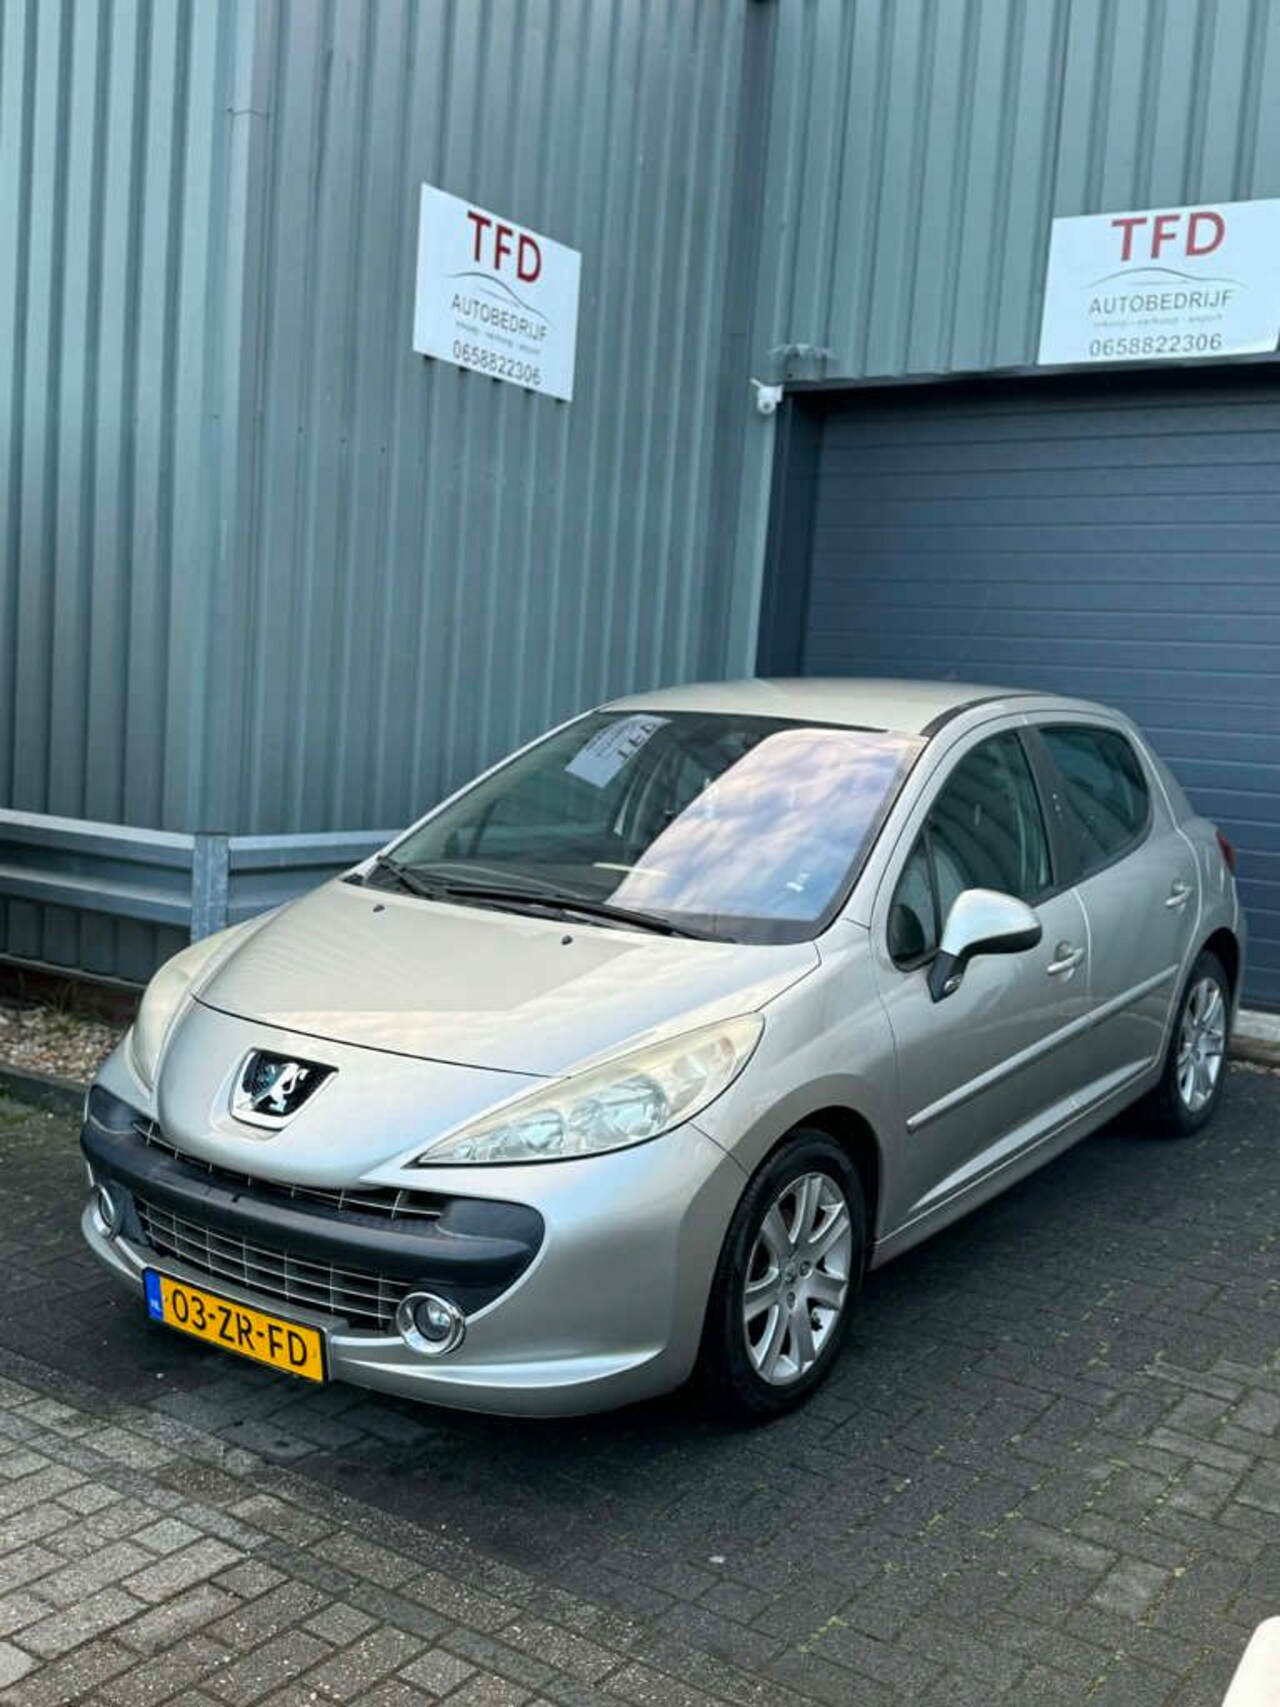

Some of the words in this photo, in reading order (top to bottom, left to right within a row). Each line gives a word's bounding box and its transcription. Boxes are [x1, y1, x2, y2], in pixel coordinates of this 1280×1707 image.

[467, 210, 541, 283] TFD
[1111, 211, 1226, 262] TFD
[452, 294, 547, 340] AUTOBEDRIJF
[1088, 289, 1234, 315] AUTOBEDRIJF
[453, 340, 541, 386] 0658822306
[1089, 333, 1222, 357] 0658822306
[172, 1289, 307, 1366] 03-ZR-FD
